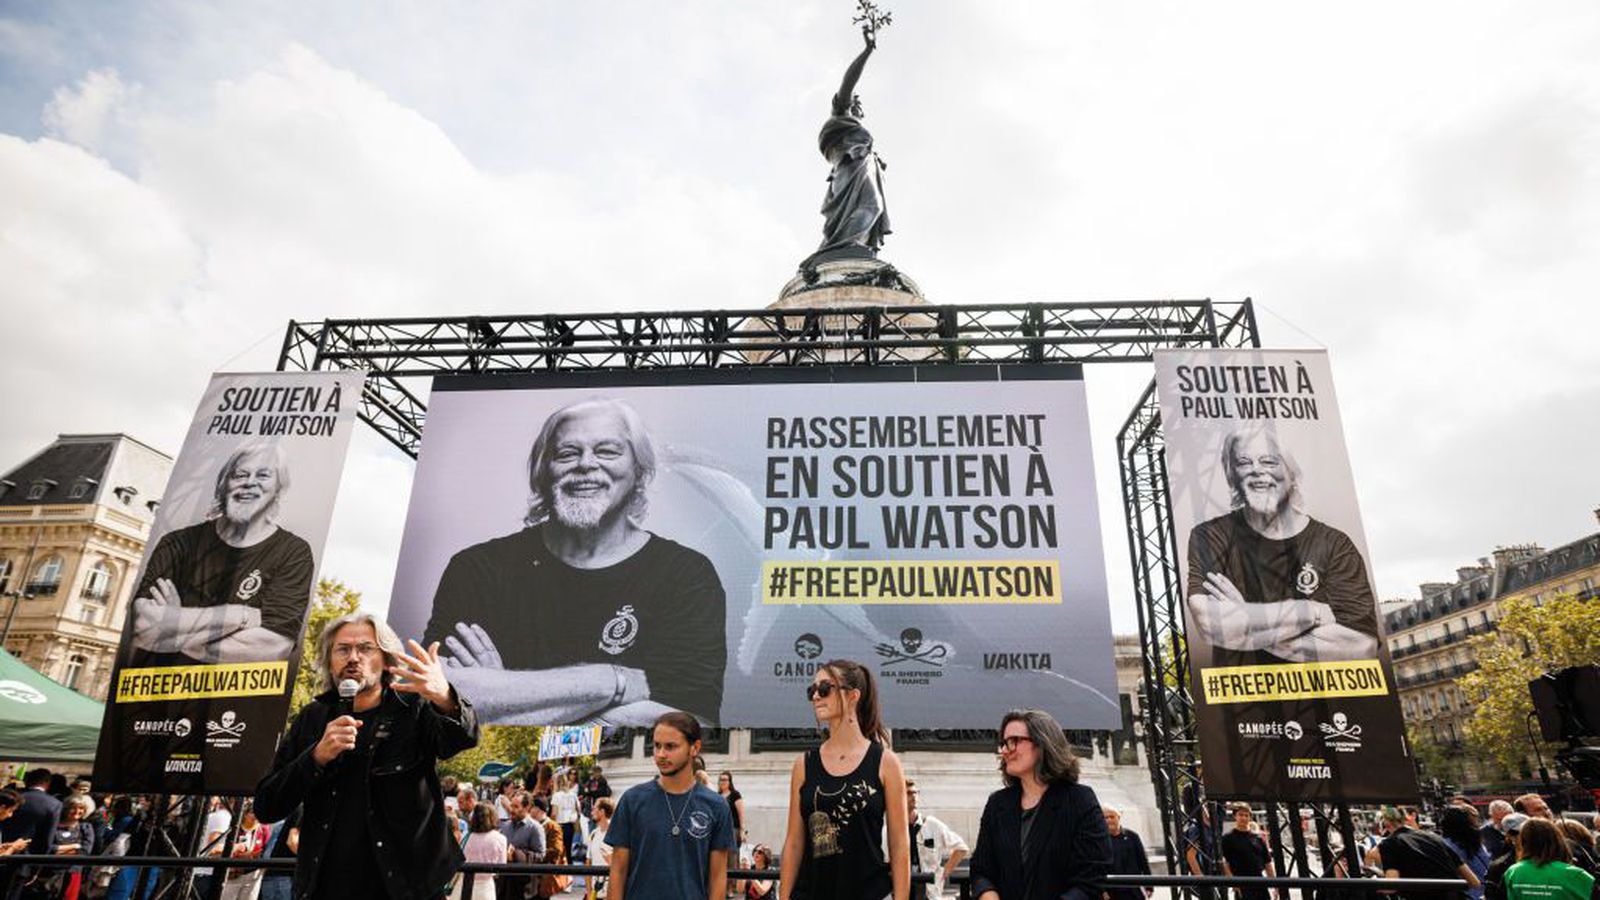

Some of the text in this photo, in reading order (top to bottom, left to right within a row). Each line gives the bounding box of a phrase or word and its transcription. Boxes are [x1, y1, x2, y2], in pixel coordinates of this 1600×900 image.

[1176, 360, 1314, 394] SOUTIEN À
[218, 381, 342, 413] SOUTIEN À
[1180, 395, 1319, 420] PAUL WATSON
[206, 414, 337, 437] PAUL WATSON
[766, 414, 1046, 449] RASSEMBLEMENT
[765, 445, 1054, 499] EN SOUTIEN À
[763, 503, 1058, 550] PAUL WATSON
[768, 566, 1055, 598] #FREEPAULWATSON
[983, 652, 1052, 670] VAKITA
[119, 668, 284, 697] #FREEPAULWATSON
[1207, 666, 1383, 697] #FREEPAULWATSON
[164, 760, 203, 773] VAKITA
[1286, 764, 1332, 779] VAKITA
